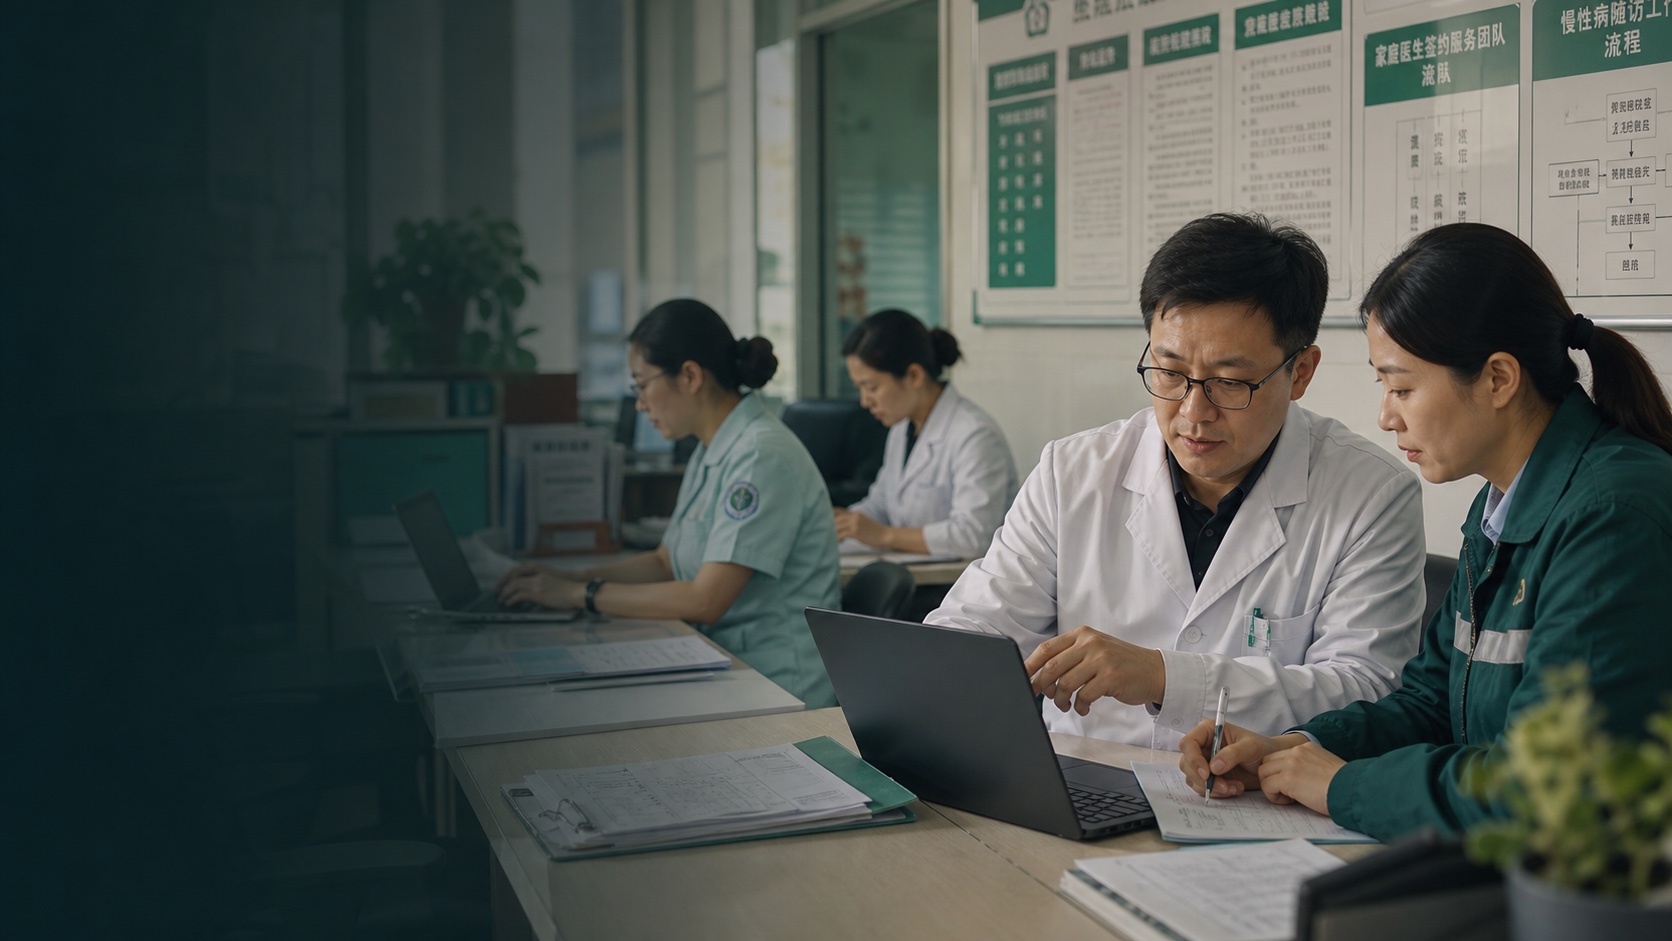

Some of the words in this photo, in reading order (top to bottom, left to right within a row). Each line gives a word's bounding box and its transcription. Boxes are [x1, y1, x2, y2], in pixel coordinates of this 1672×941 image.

[1375, 22, 1505, 67] 家庭医生签约服务团队
[1604, 29, 1641, 58] 流程
